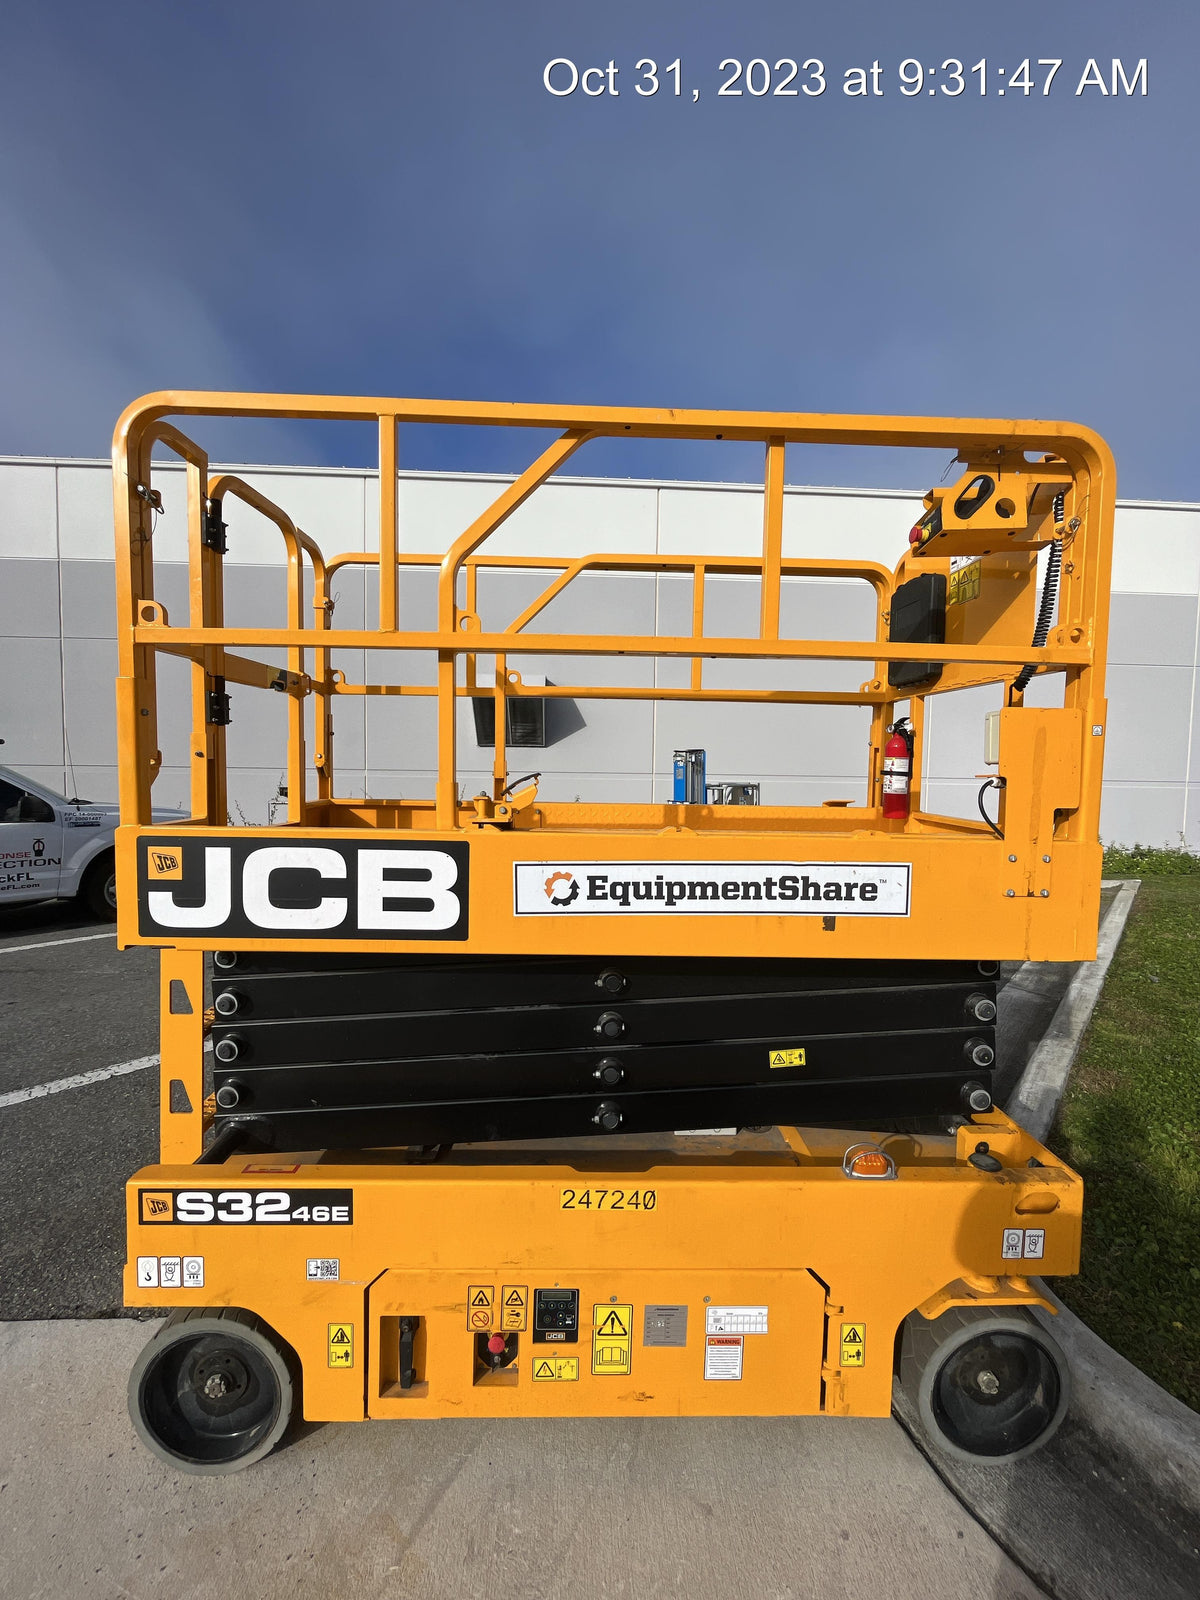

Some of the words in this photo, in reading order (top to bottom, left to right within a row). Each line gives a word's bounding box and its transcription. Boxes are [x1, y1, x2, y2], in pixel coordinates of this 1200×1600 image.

[156, 854, 178, 871] JCB
[147, 846, 461, 931] JCB
[586, 874, 879, 906] EquipmentShare
[150, 1199, 169, 1214] JCB
[562, 1189, 657, 1210] 247240
